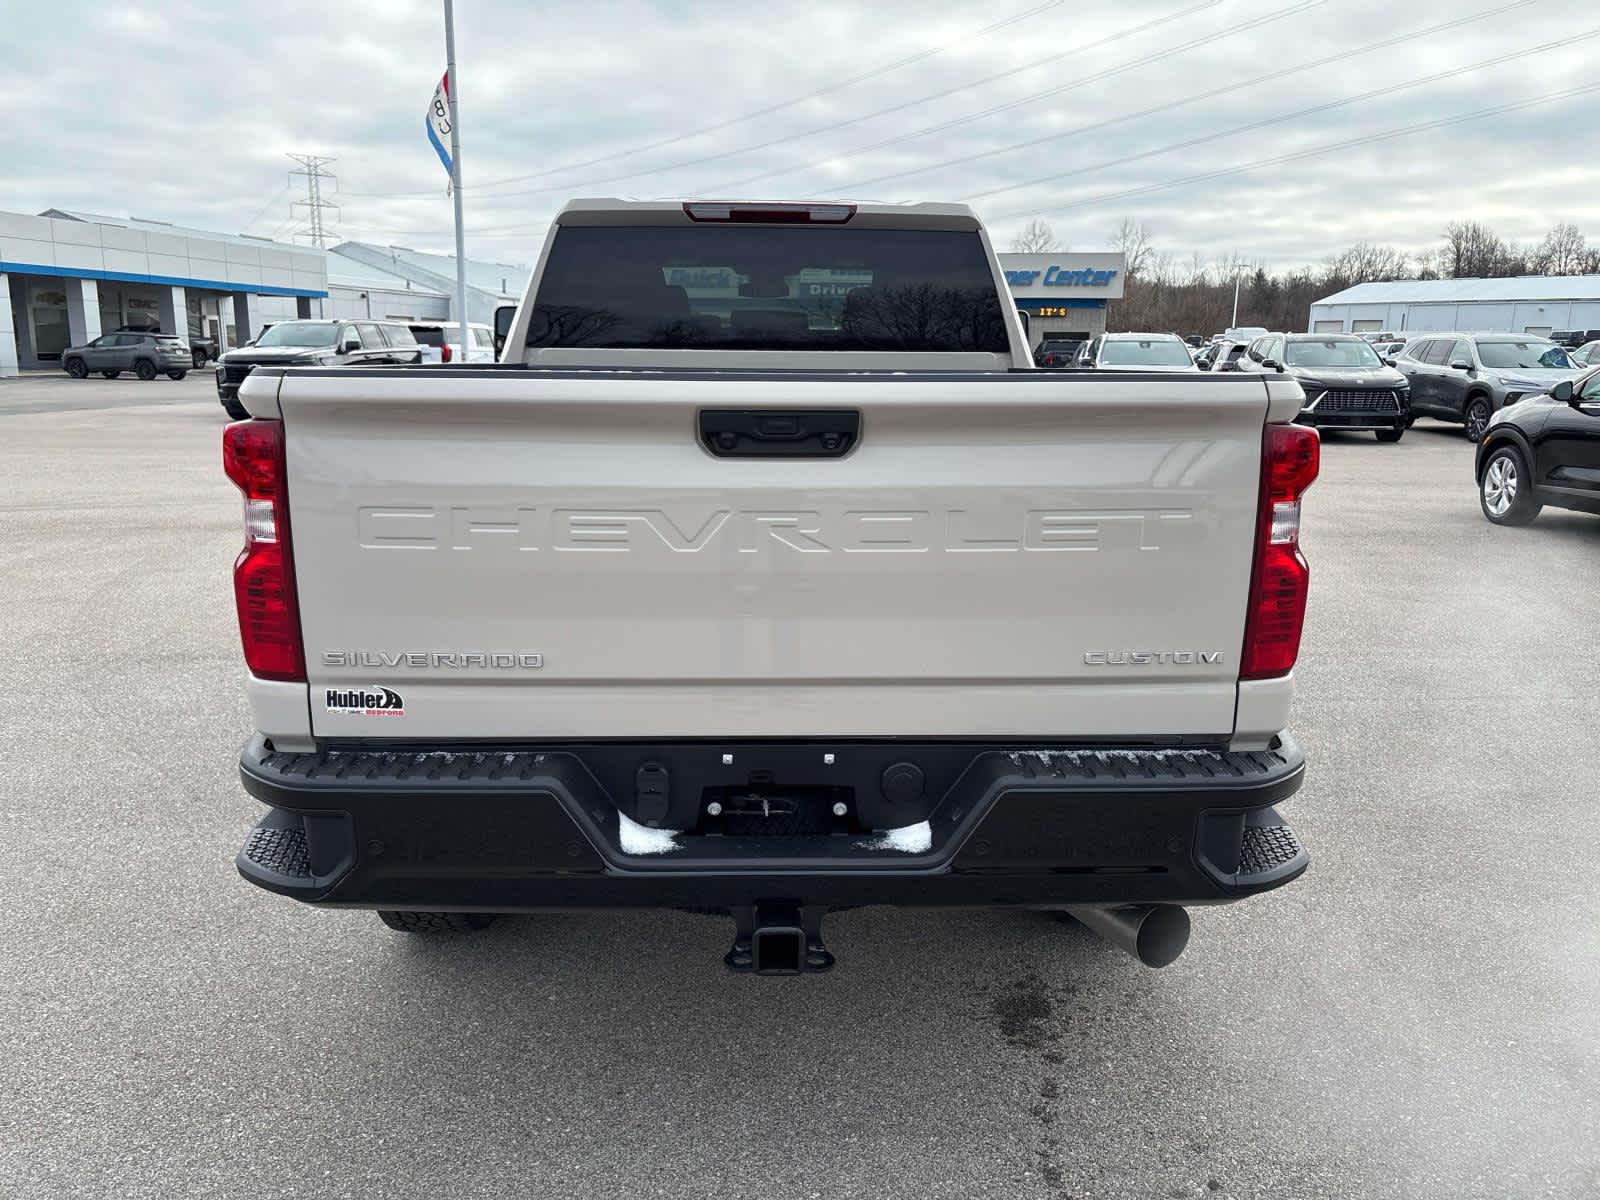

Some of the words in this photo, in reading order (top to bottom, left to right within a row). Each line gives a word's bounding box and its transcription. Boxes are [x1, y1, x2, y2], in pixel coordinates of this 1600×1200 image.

[1043, 265, 1118, 287] Center
[1039, 307, 1067, 316] IT'S
[359, 506, 1193, 554] CHEVROLET
[321, 650, 544, 669] SILVERADO
[1083, 650, 1225, 665] CUSTOM
[326, 689, 383, 709] Hubler
